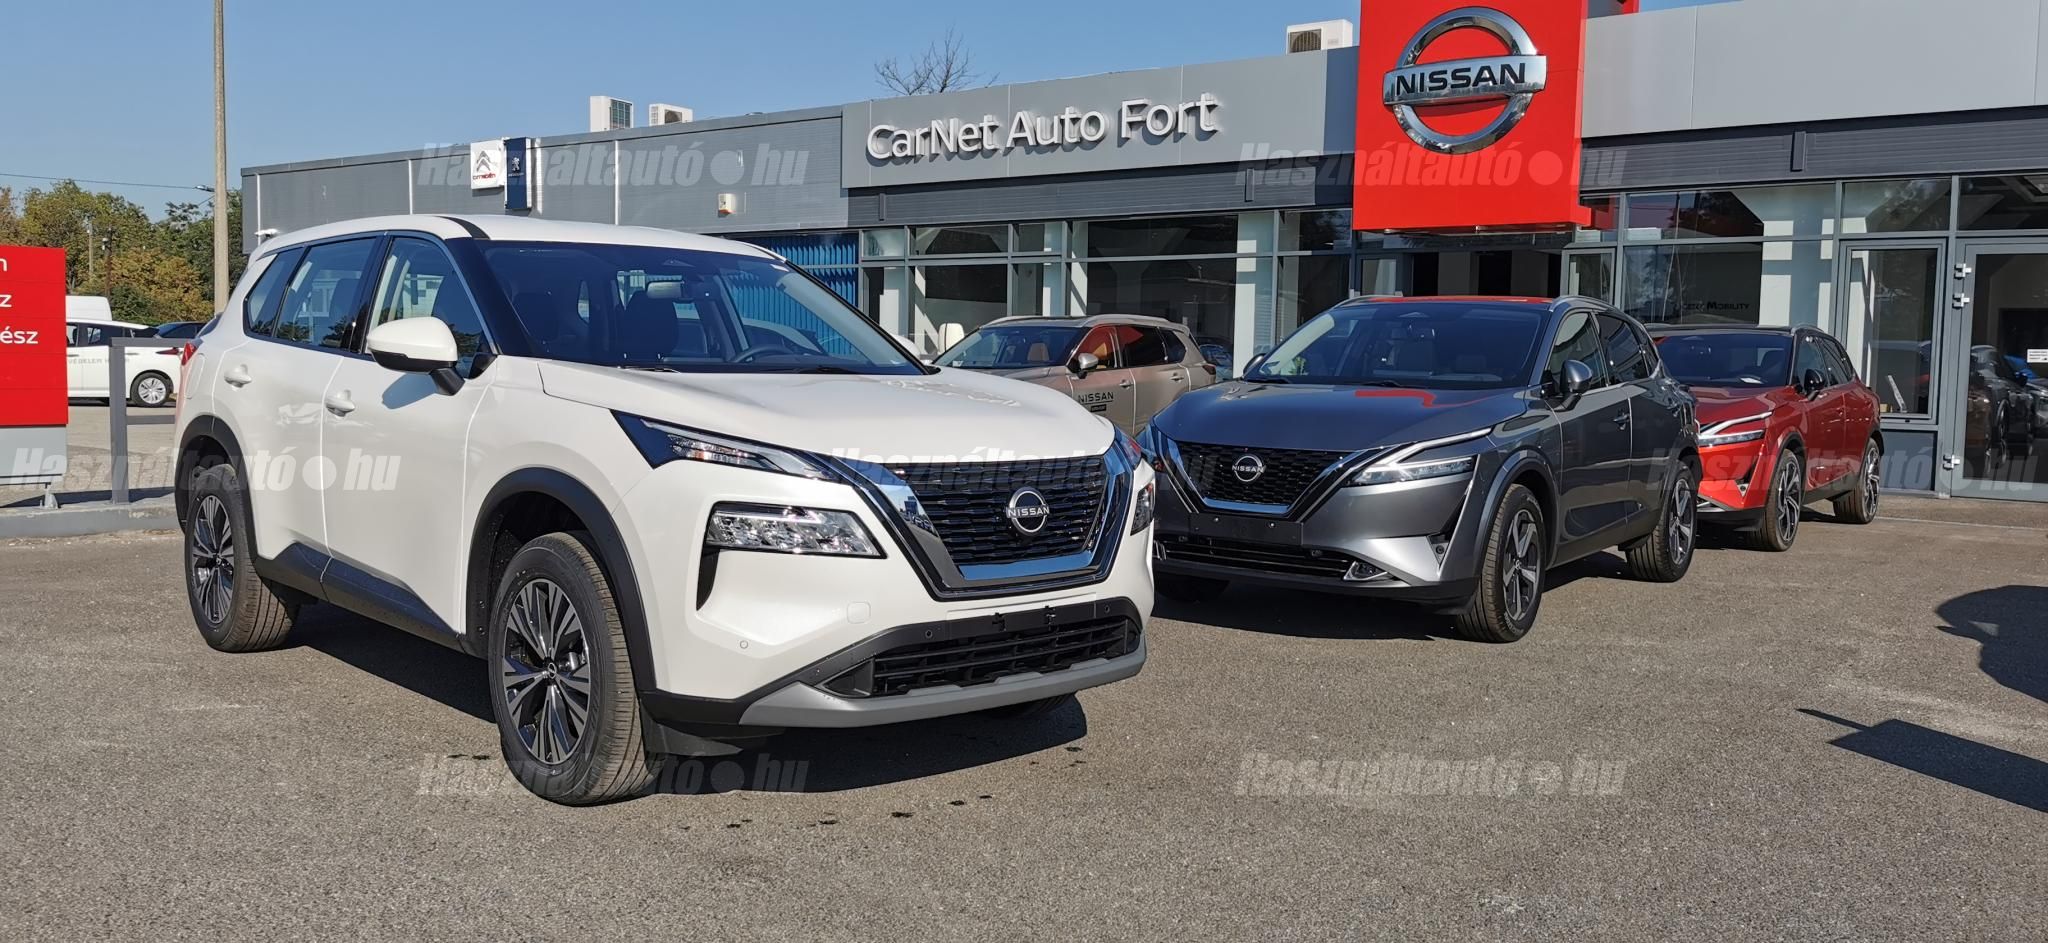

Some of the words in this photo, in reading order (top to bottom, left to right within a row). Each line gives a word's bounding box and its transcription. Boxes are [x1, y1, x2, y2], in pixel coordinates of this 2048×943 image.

[1396, 62, 1526, 96] NISSAN
[866, 113, 1001, 161] CarNet
[1005, 105, 1110, 149] Auto
[1120, 91, 1222, 139] Fort
[1078, 391, 1114, 402] NISSAN
[1231, 464, 1266, 474] NISSAN
[1007, 506, 1050, 517] NISSAN
